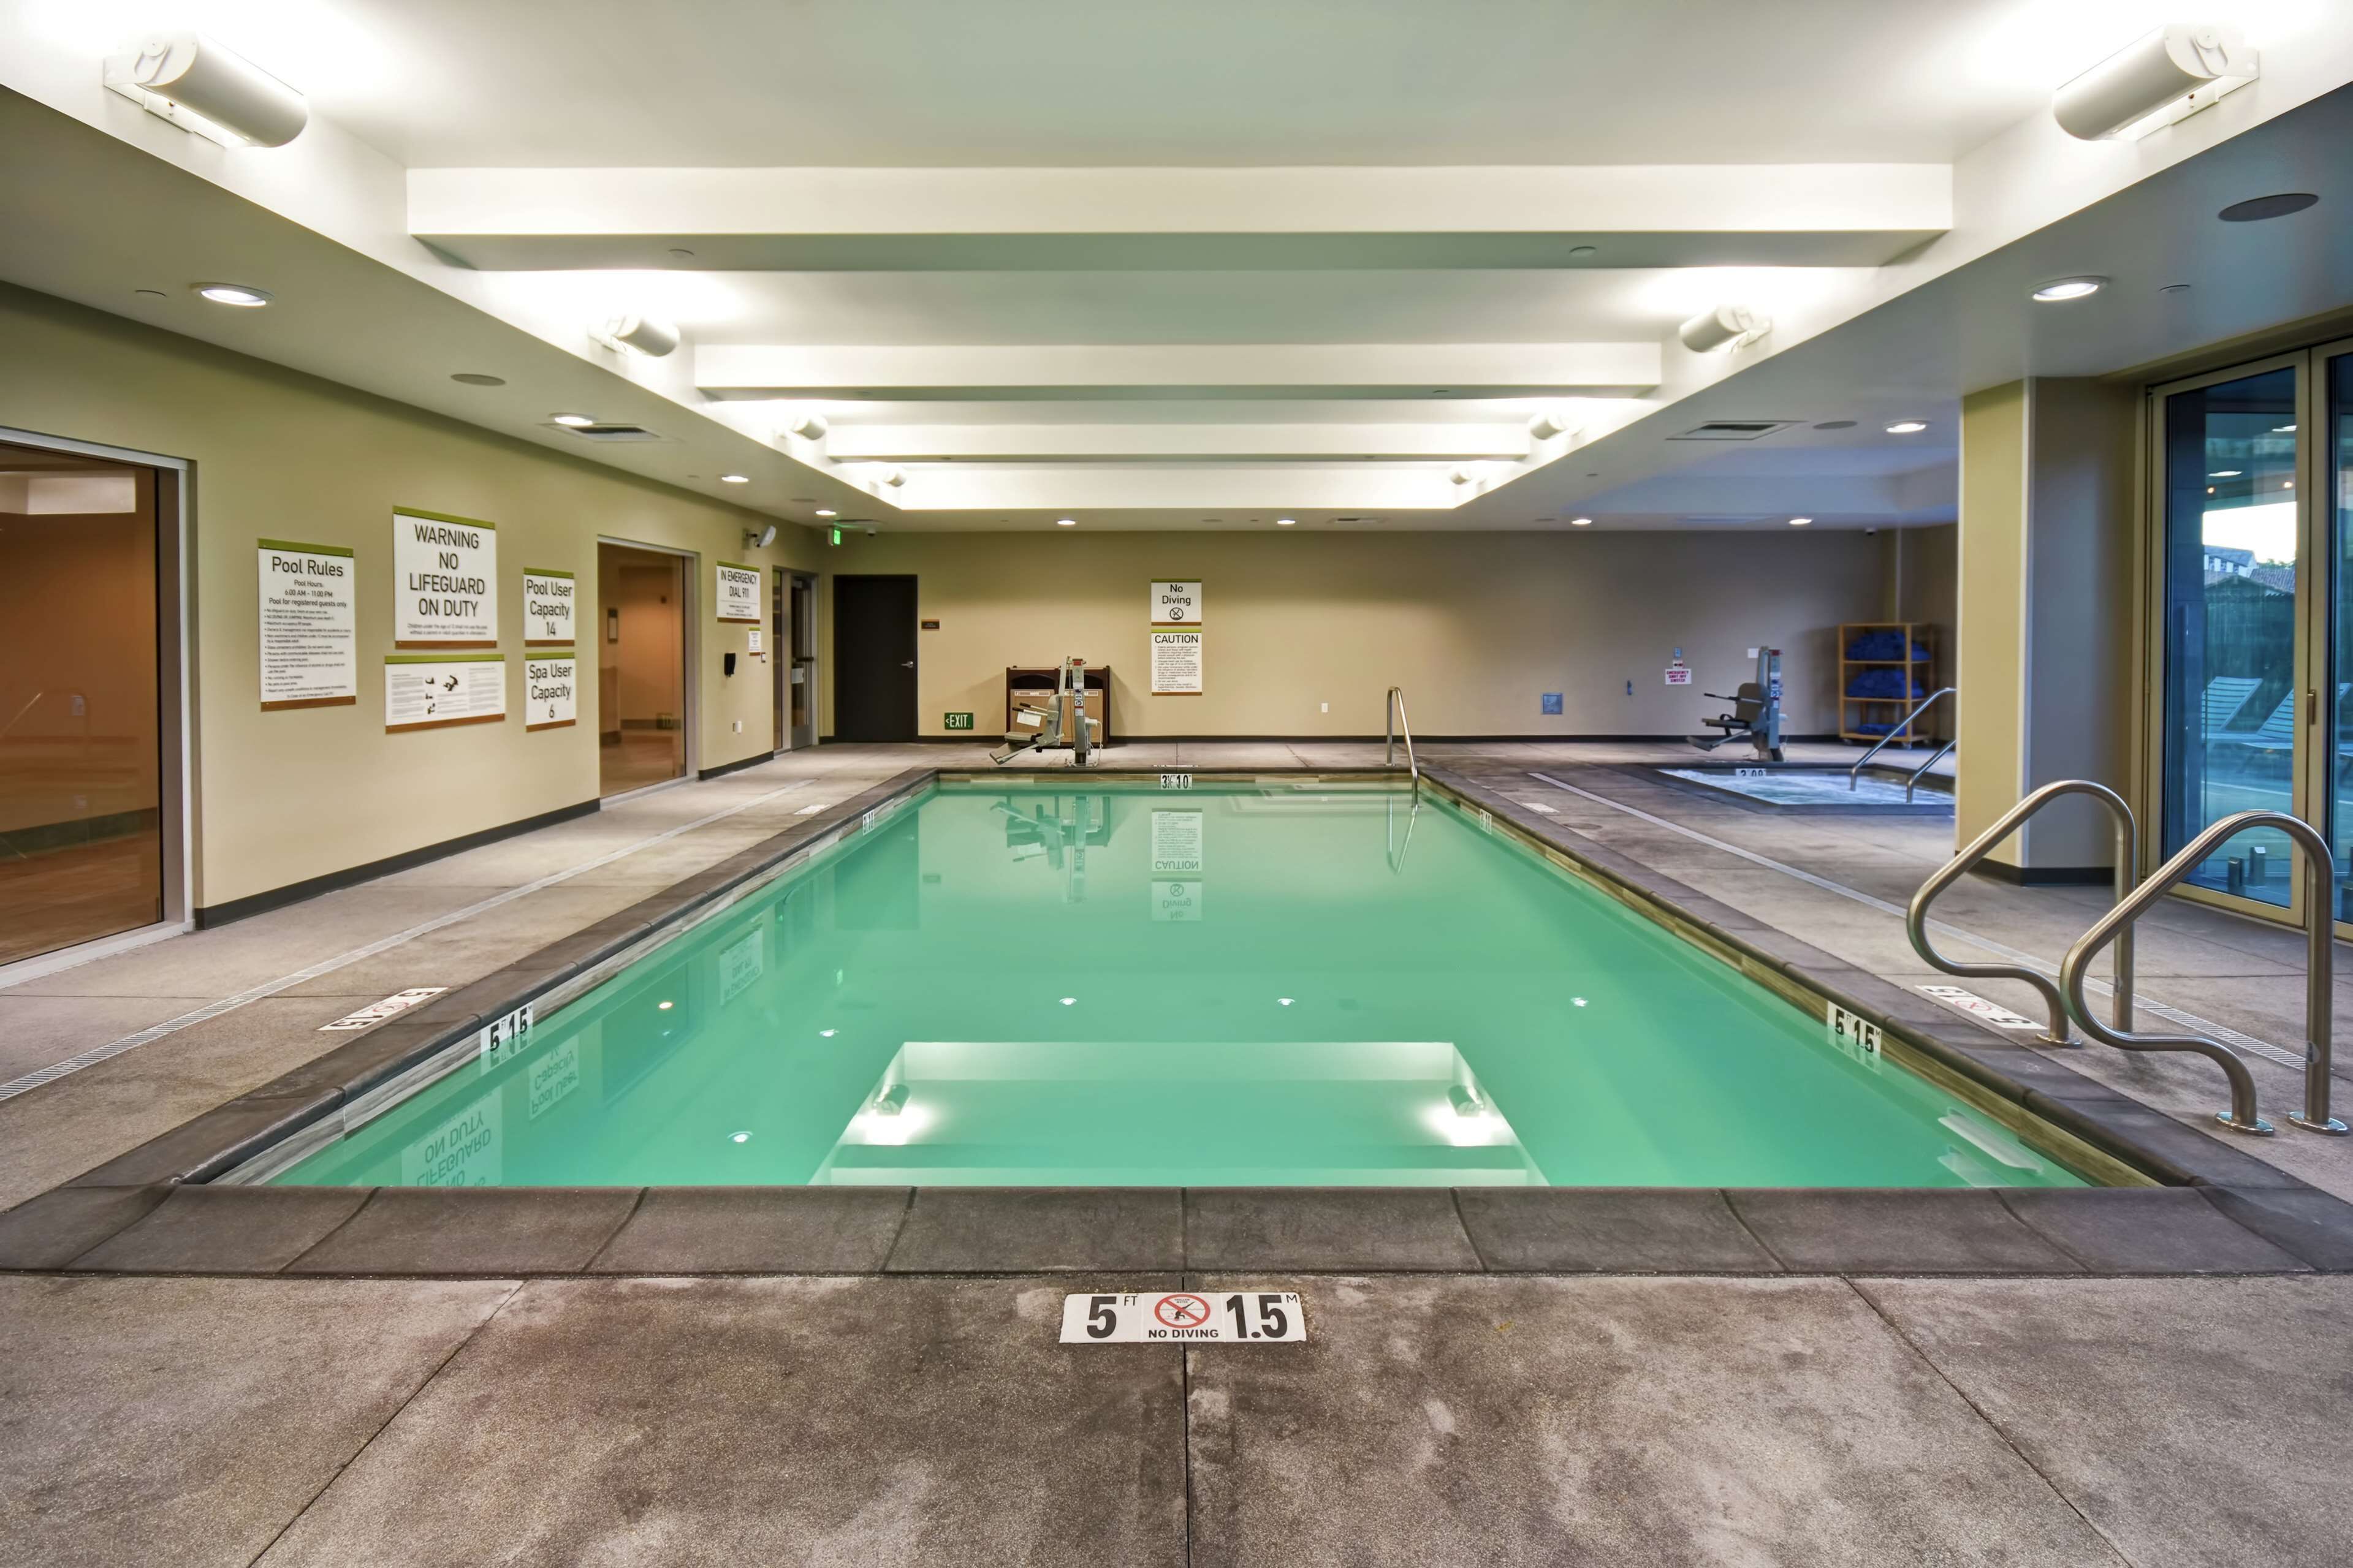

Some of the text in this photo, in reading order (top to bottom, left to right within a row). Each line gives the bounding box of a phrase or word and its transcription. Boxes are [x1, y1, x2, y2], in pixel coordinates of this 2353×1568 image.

[414, 524, 479, 549] WARNING
[272, 556, 344, 577] Pool Rules
[439, 551, 458, 570] NO
[409, 573, 485, 595] LIFEGUARD
[721, 569, 757, 585] IN EMERGENCY
[526, 579, 572, 597] Pool User
[729, 586, 741, 597] DIAL
[1170, 584, 1184, 593] No
[292, 599, 318, 607] registered
[419, 598, 479, 617] ON DUTY
[530, 600, 570, 620] Capacity
[1162, 596, 1192, 606] Diving
[545, 621, 556, 637] 14
[1155, 634, 1199, 643] CAUTION
[529, 664, 572, 681] Spa User
[531, 684, 571, 702] Capacity
[549, 705, 555, 719] 6
[949, 714, 967, 727] EXIT
[1835, 1008, 1845, 1036] 5
[490, 1023, 500, 1051] 5
[1086, 1295, 1138, 1339] 5 FT
[1226, 1295, 1298, 1339] 1.5 M
[1148, 1329, 1219, 1339] NO DIVING
